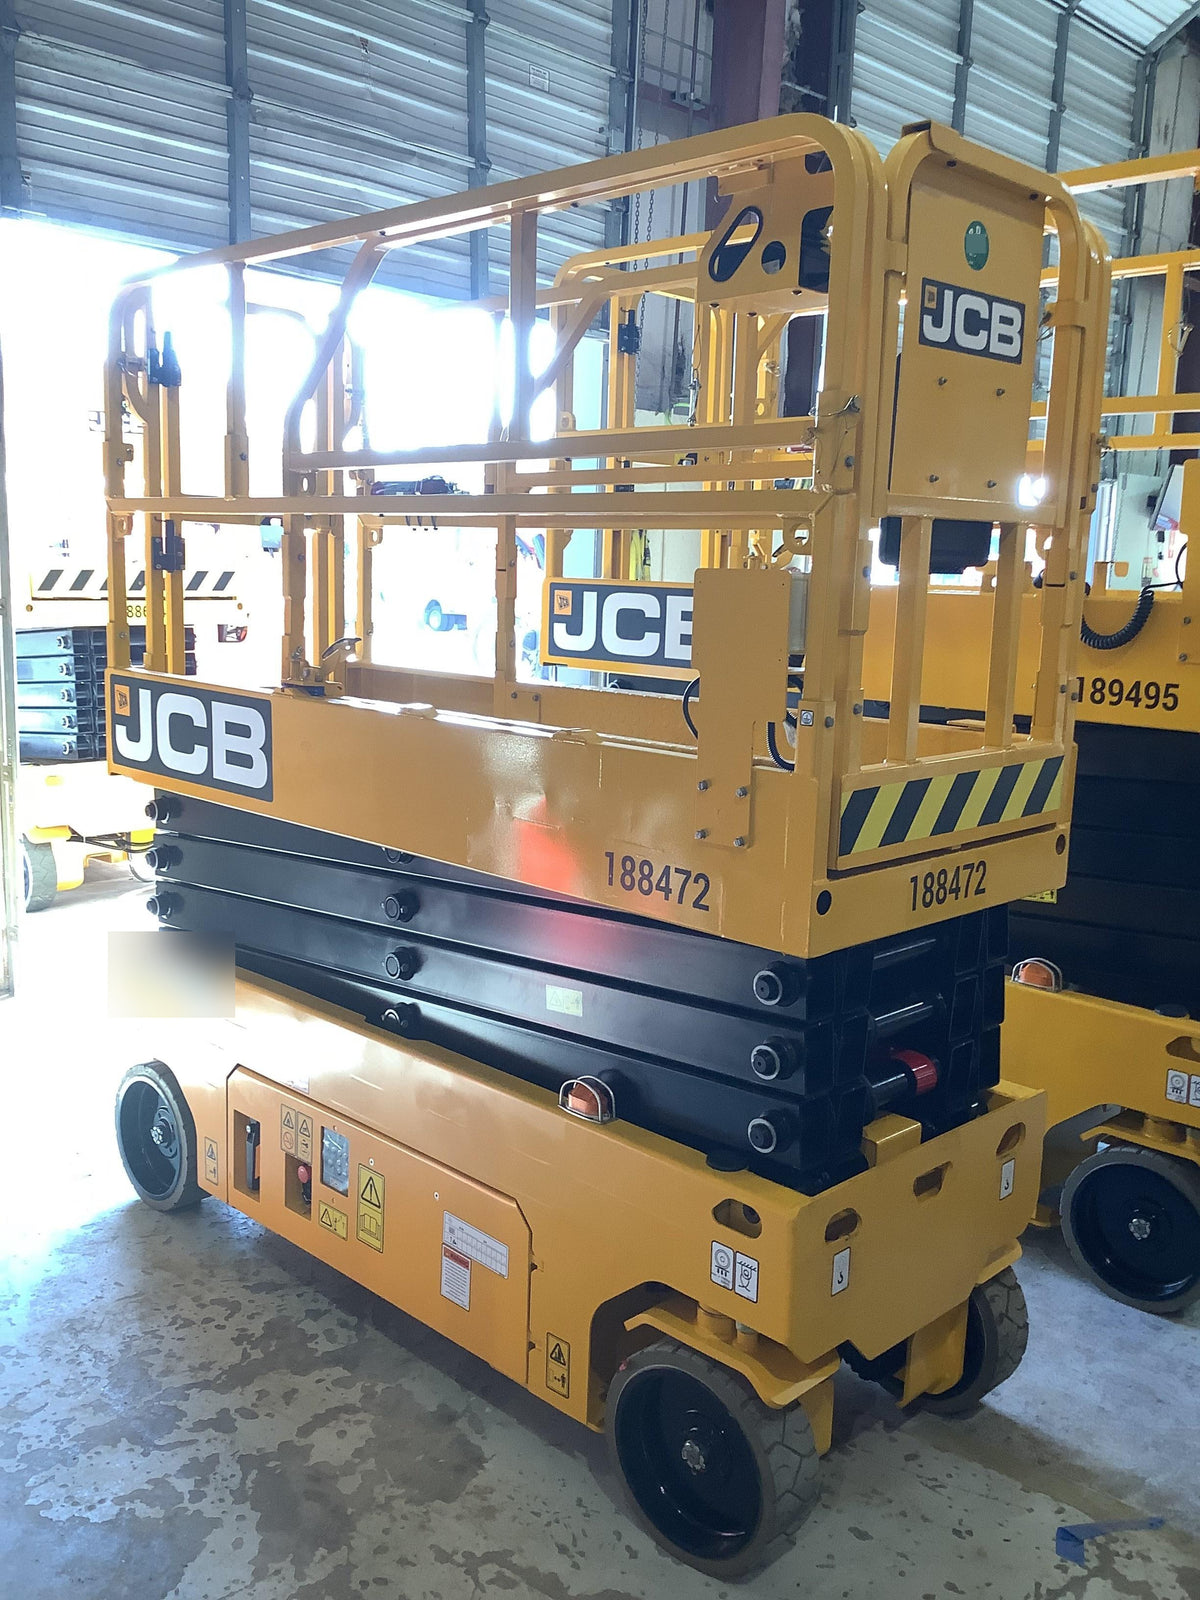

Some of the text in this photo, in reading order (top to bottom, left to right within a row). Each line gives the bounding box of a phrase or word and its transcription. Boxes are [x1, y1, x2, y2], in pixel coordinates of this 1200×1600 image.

[922, 289, 1022, 358] JCB
[1075, 676, 1180, 712] 189495
[115, 688, 268, 789] JCB
[604, 851, 711, 912] 188472
[910, 860, 987, 912] 188472
